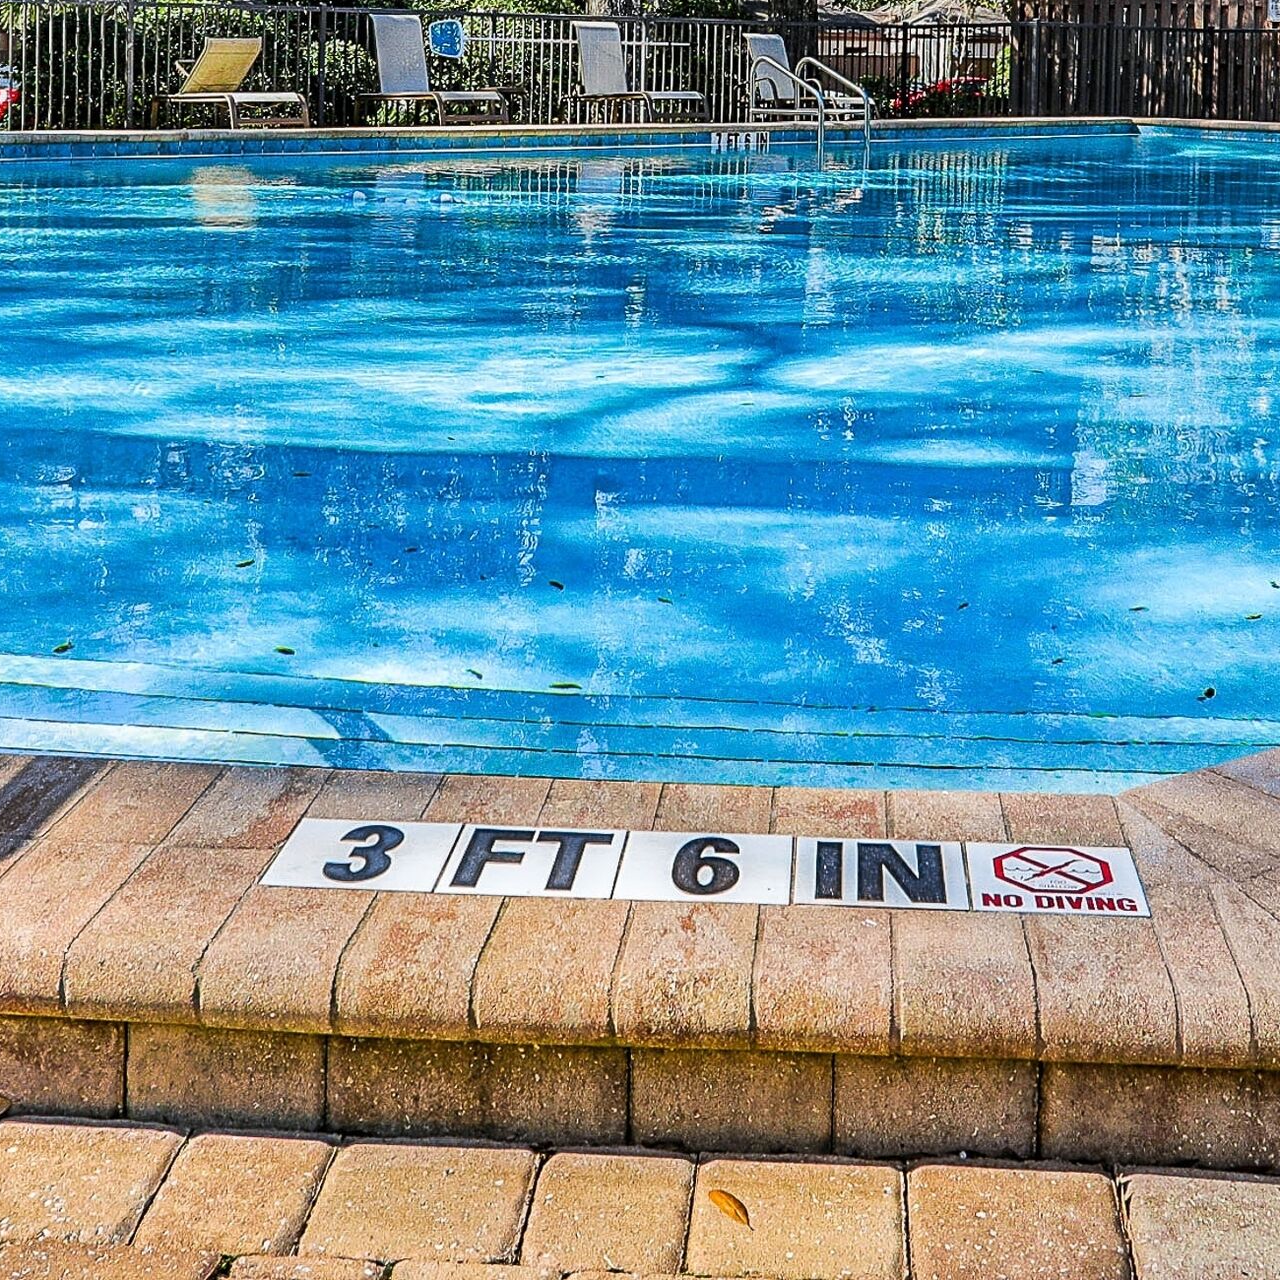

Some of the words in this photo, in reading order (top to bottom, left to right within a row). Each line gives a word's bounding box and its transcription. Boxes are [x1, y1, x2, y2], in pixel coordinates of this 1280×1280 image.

[756, 133, 768, 144] IN
[322, 824, 405, 883] 3
[449, 827, 614, 892] FT
[671, 836, 741, 895] 6
[814, 840, 948, 904] IN
[981, 892, 1024, 907] NO
[1034, 895, 1138, 912] DIVING
